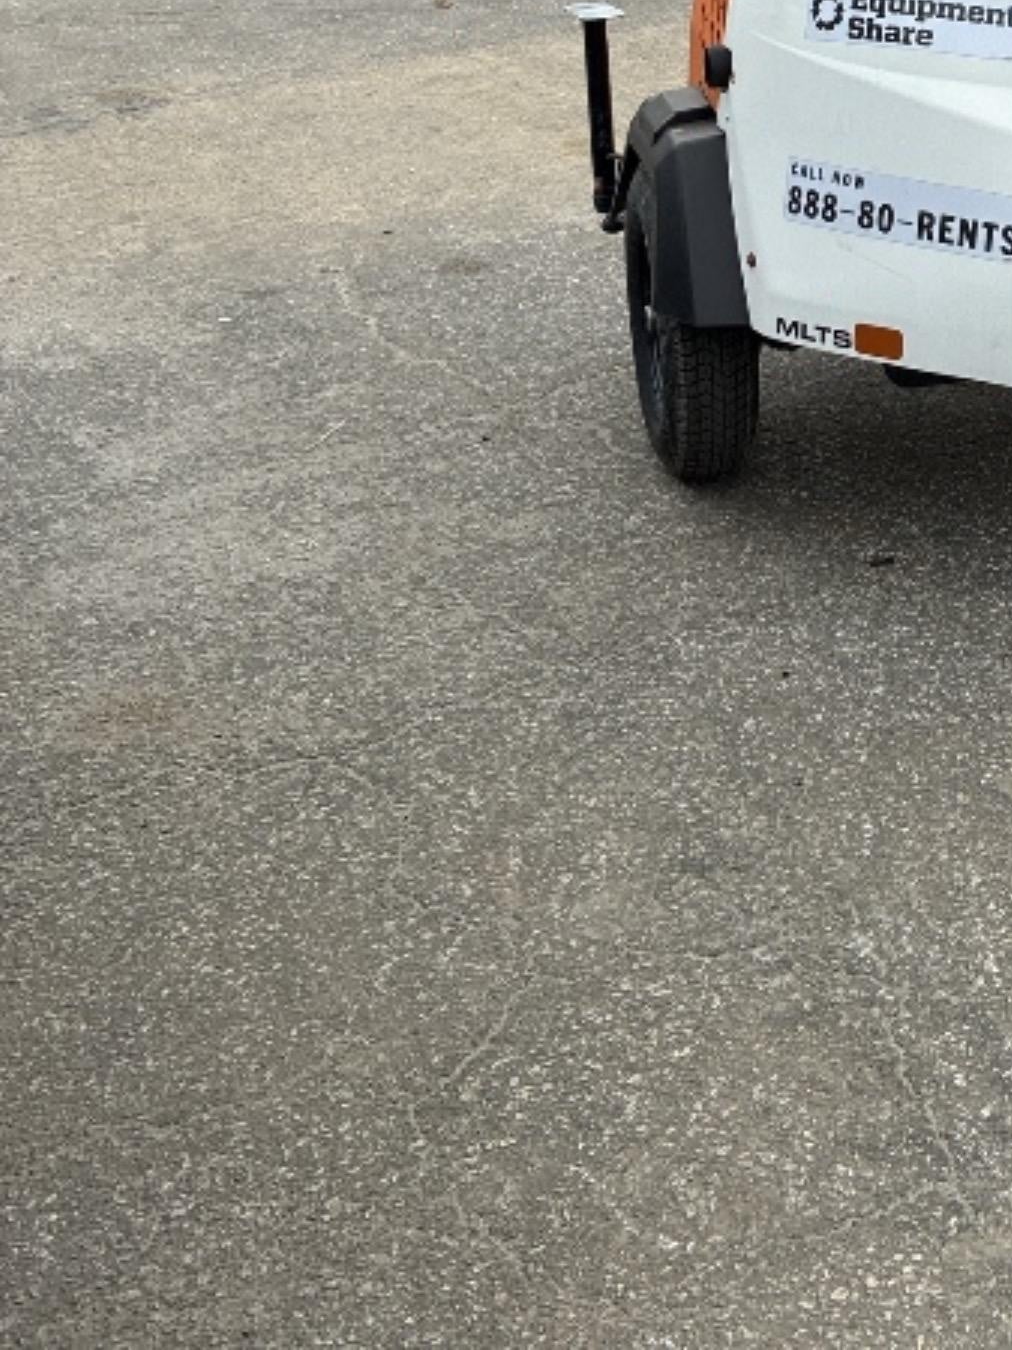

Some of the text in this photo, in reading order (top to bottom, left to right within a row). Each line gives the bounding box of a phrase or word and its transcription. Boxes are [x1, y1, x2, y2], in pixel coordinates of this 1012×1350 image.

[848, 17, 934, 46] Share
[791, 162, 865, 190] CALL NOW
[776, 317, 853, 349] MLTS
